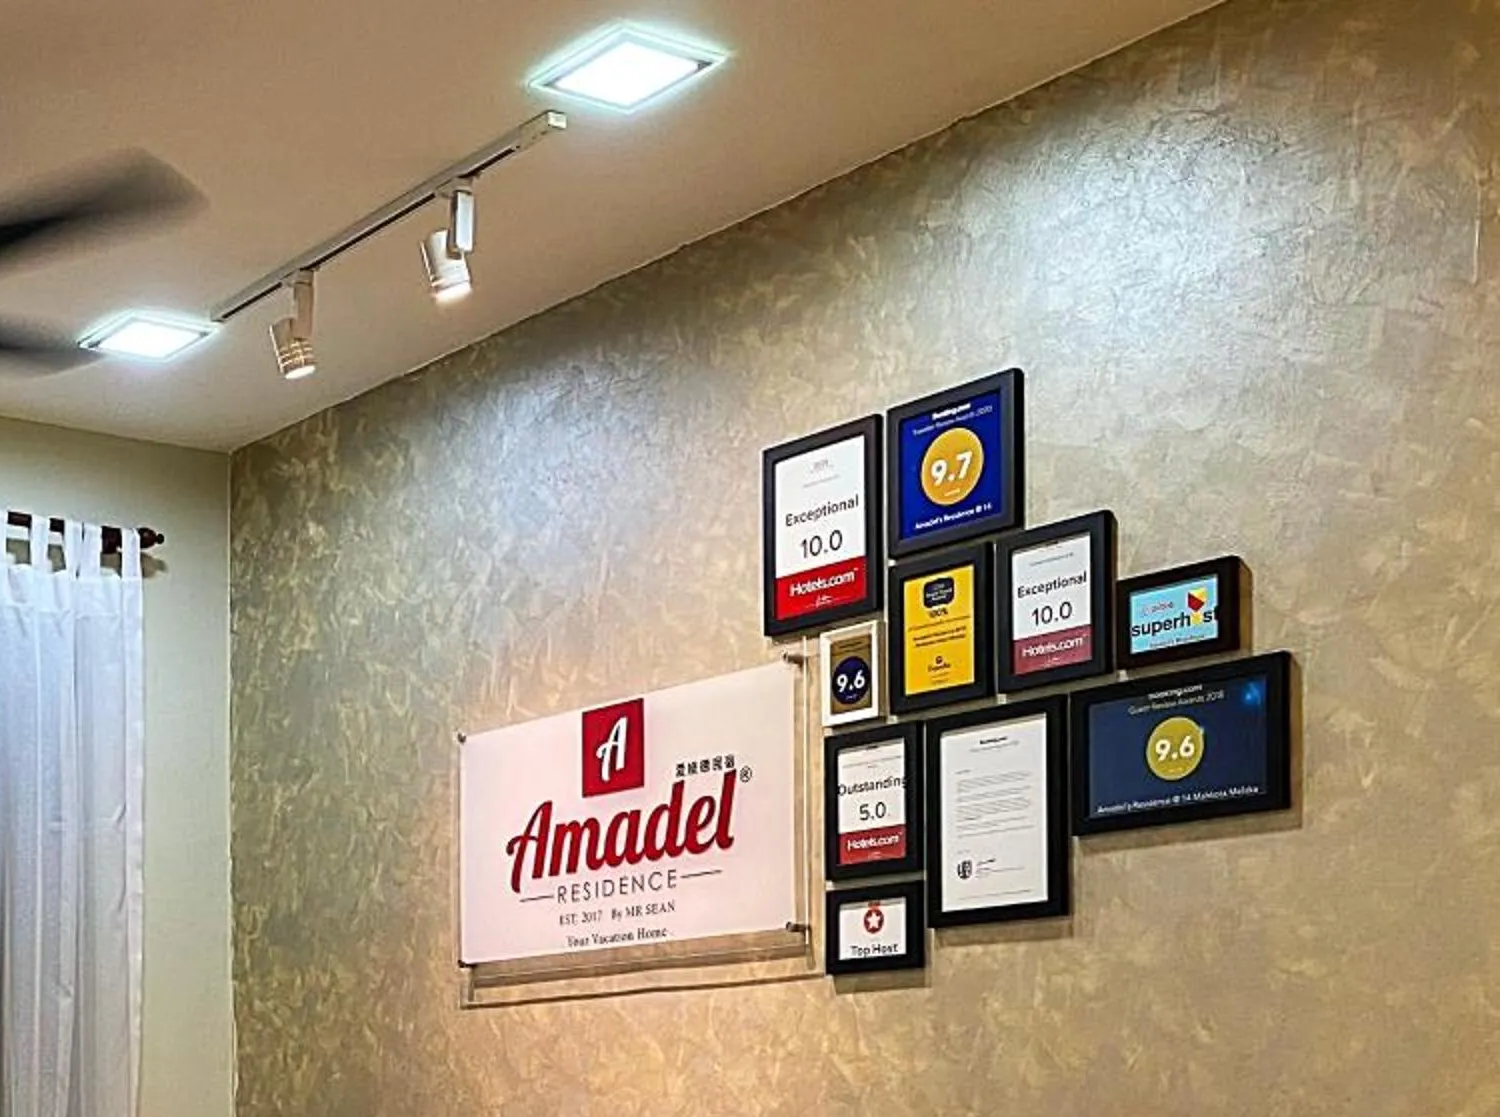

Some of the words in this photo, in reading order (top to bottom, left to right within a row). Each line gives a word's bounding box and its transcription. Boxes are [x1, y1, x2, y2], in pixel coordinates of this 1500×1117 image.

[931, 450, 973, 486] 9.7
[785, 494, 859, 527] Exceptional
[800, 529, 843, 559] 10.0
[789, 571, 856, 597] Hotels.com
[1017, 570, 1087, 598] Exceptional
[1032, 601, 1073, 626] 10.0
[1022, 637, 1083, 657] Hotels.com
[837, 670, 865, 692] 9.6
[596, 717, 628, 782] A
[1155, 735, 1195, 761] 9.6
[859, 801, 886, 821] 5.0
[846, 834, 899, 852] Hotels.com
[557, 868, 678, 904] RESIDENCE
[581, 910, 603, 925] 2017
[611, 907, 623, 921] By
[625, 904, 643, 918] MR
[645, 899, 676, 916] SEAN
[591, 930, 635, 945] Vacation
[637, 926, 668, 941] Home
[850, 945, 870, 959] Top
[872, 943, 899, 955] Host
